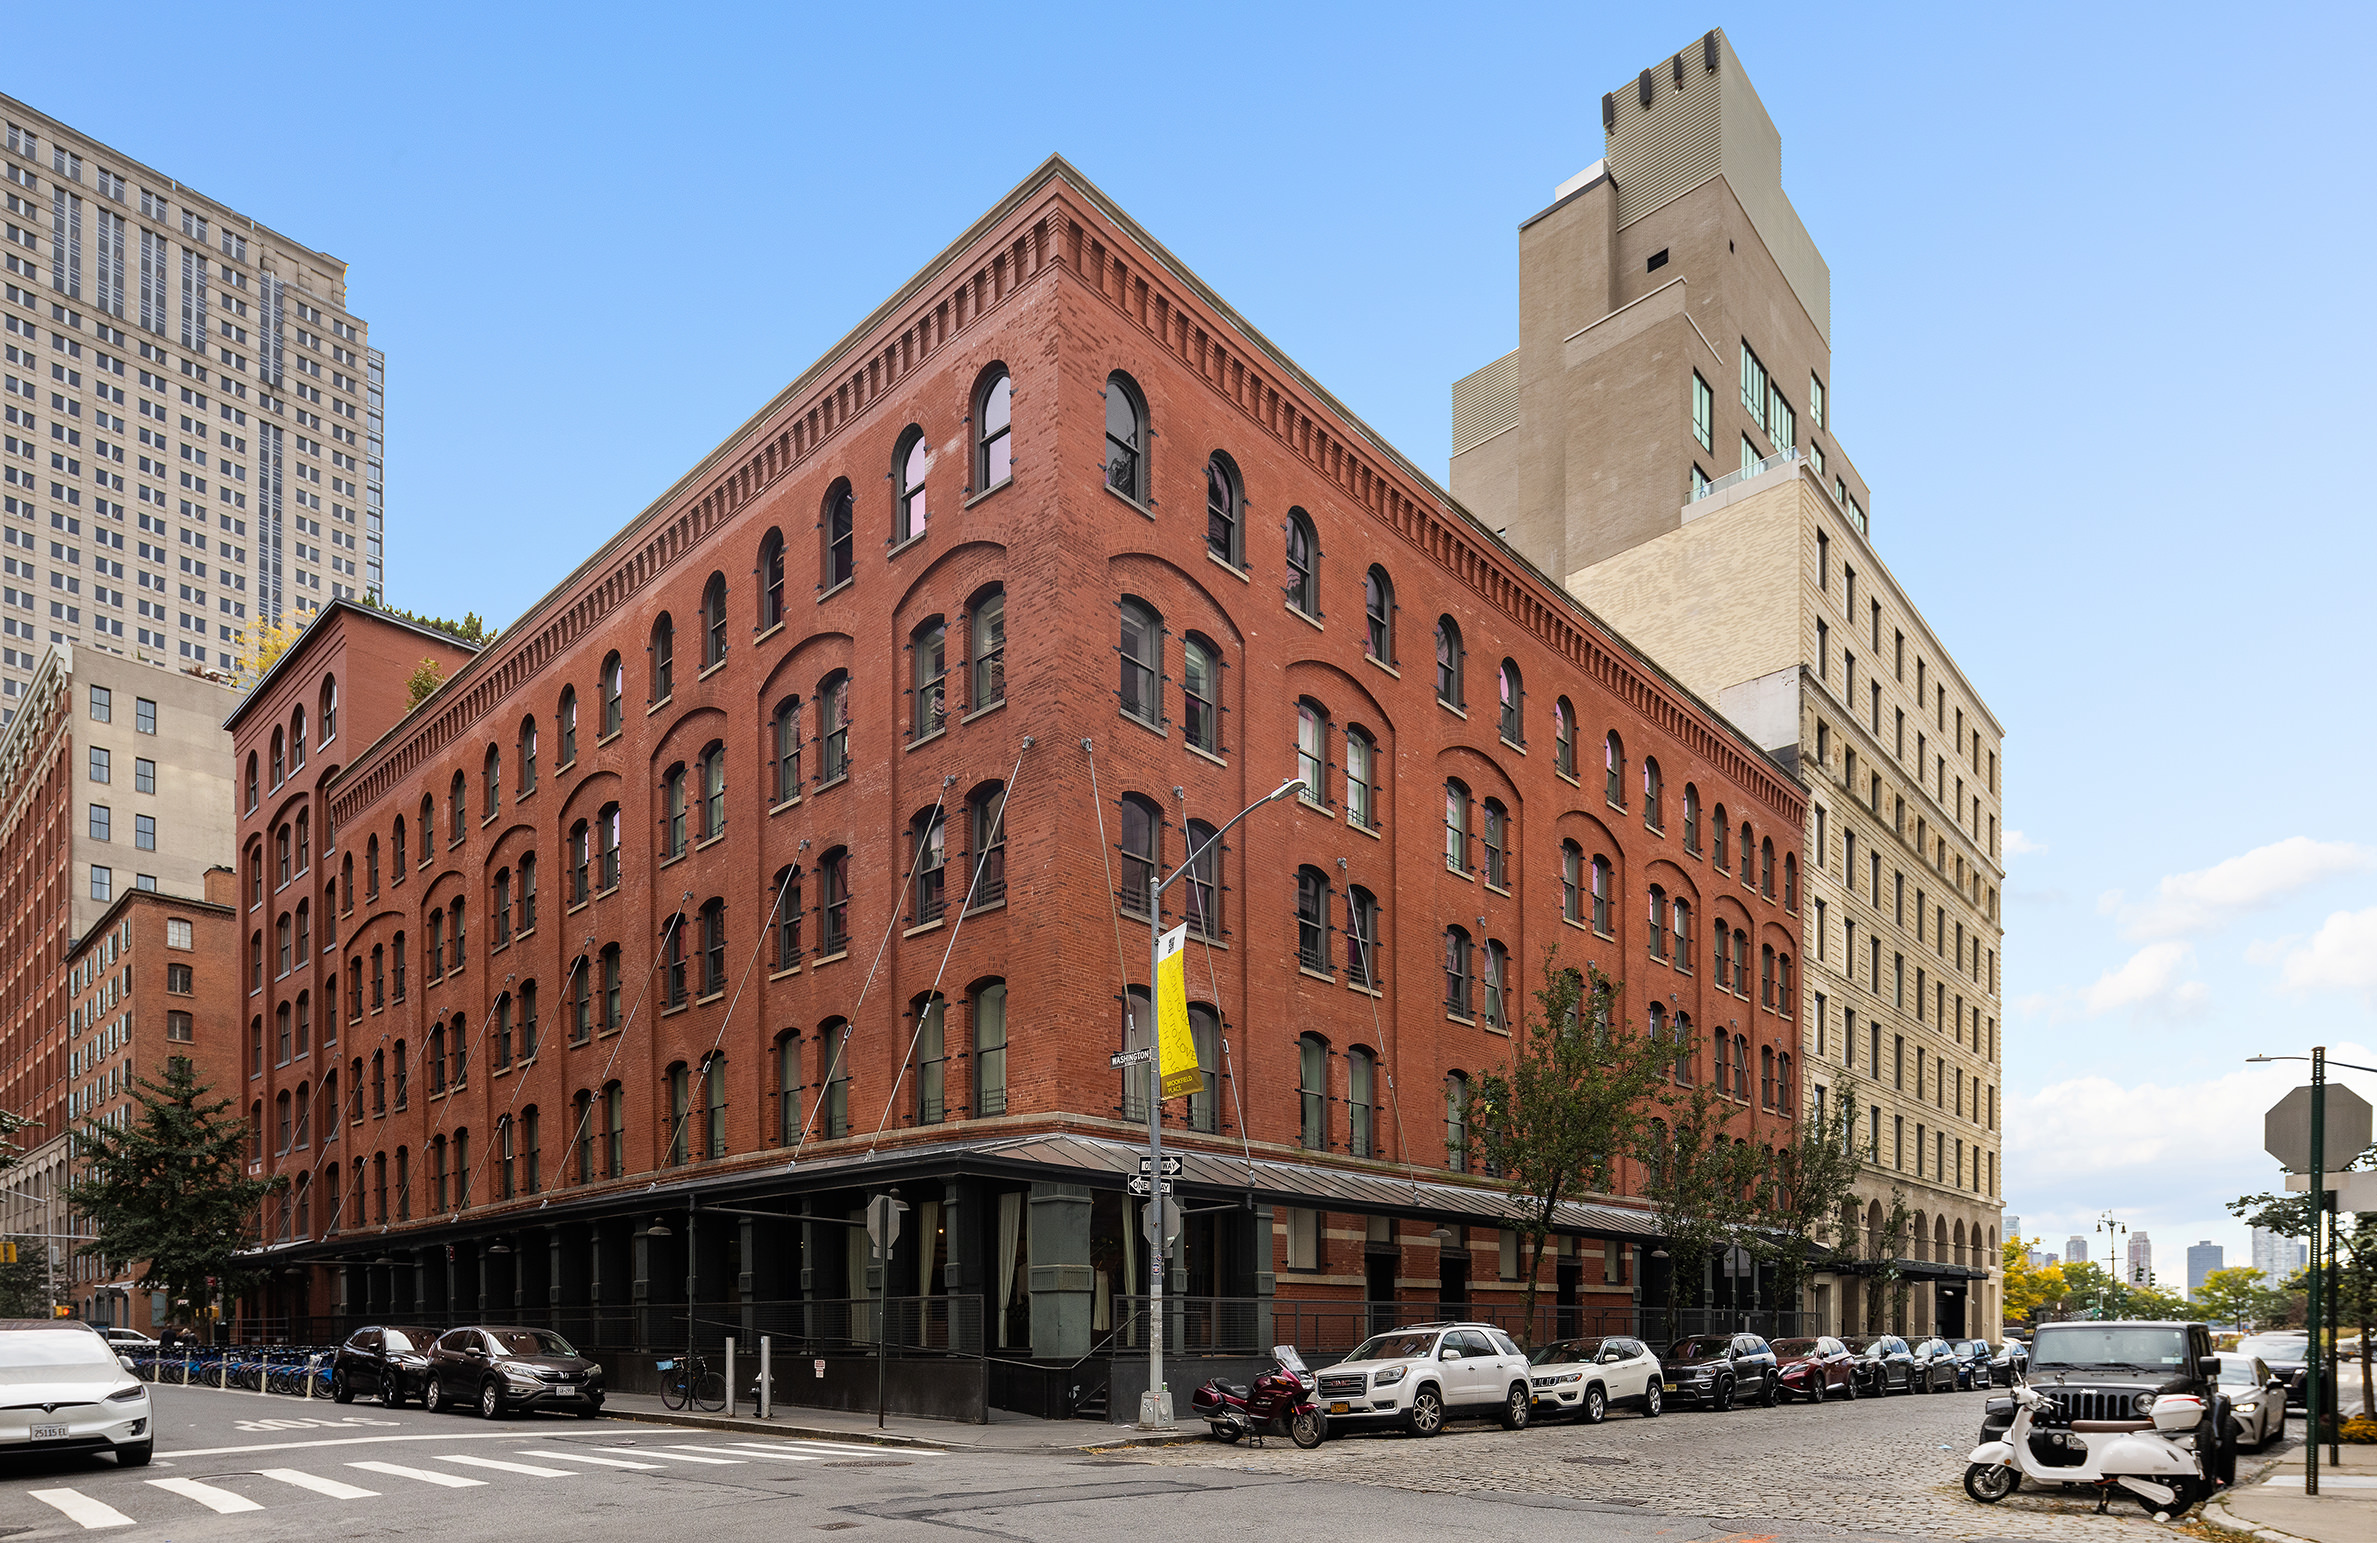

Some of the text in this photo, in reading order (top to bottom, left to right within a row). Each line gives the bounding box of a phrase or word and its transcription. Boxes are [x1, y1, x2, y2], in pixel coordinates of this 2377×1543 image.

[1175, 1038, 1196, 1061] LOVE
[1112, 1050, 1149, 1065] WASHINGTON
[1166, 1075, 1193, 1088] BROOKFIELD
[1168, 1085, 1182, 1094] PLACE
[1133, 1181, 1148, 1189] ONE
